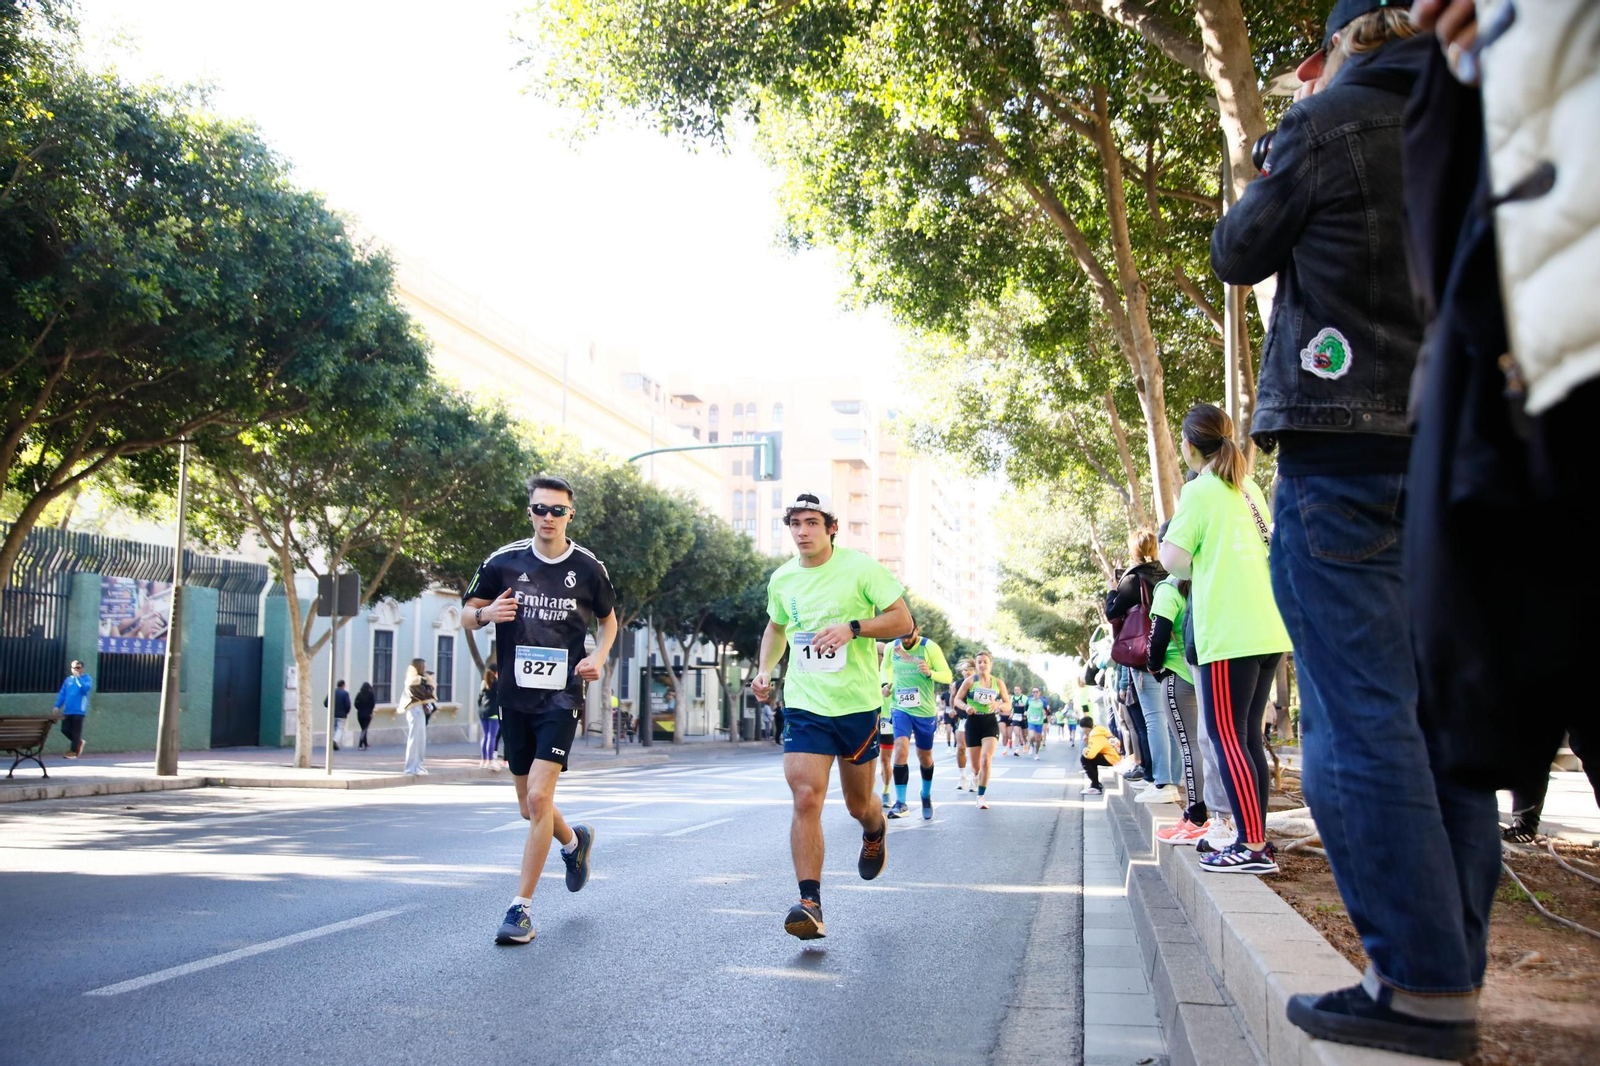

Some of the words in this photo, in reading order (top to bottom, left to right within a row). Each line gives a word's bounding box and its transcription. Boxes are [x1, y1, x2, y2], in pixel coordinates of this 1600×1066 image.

[515, 591, 577, 610] Emirates
[523, 660, 557, 676] 827
[900, 694, 915, 702] 548
[1169, 698, 1177, 709] NEW
[1172, 709, 1181, 721] YORK
[1175, 720, 1184, 731] CITY
[1179, 732, 1187, 743] NEW
[1182, 743, 1190, 755] YORK
[1184, 755, 1192, 766] CITY
[1185, 767, 1193, 778] NEW
[1187, 778, 1195, 790] YORK
[1188, 790, 1196, 800] CITY
